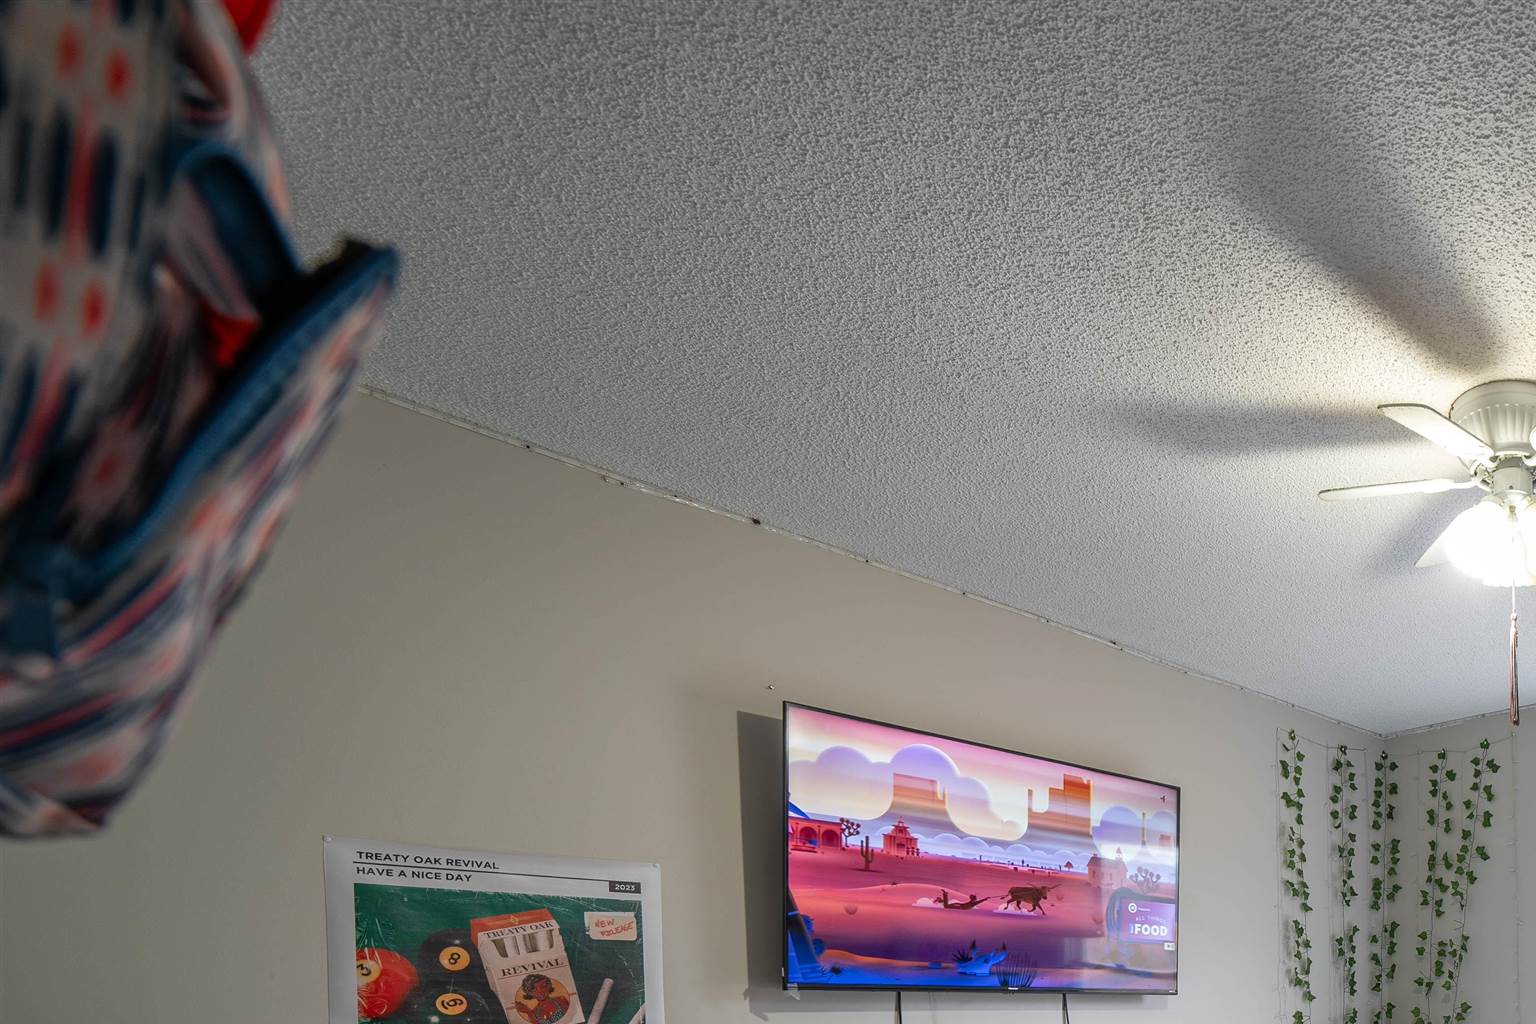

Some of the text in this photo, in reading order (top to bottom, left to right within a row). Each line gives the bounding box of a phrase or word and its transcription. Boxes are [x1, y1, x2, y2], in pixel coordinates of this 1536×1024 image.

[356, 851, 499, 870] TREATY OAK REVIVAL
[356, 866, 472, 882] HAVE A NICE DAY
[614, 883, 635, 892] 2023
[483, 921, 554, 939] TREATY OAK
[594, 918, 615, 929] NEW
[1134, 923, 1168, 936] FOOD
[448, 952, 461, 965] 8
[501, 958, 565, 977] REVIVAL
